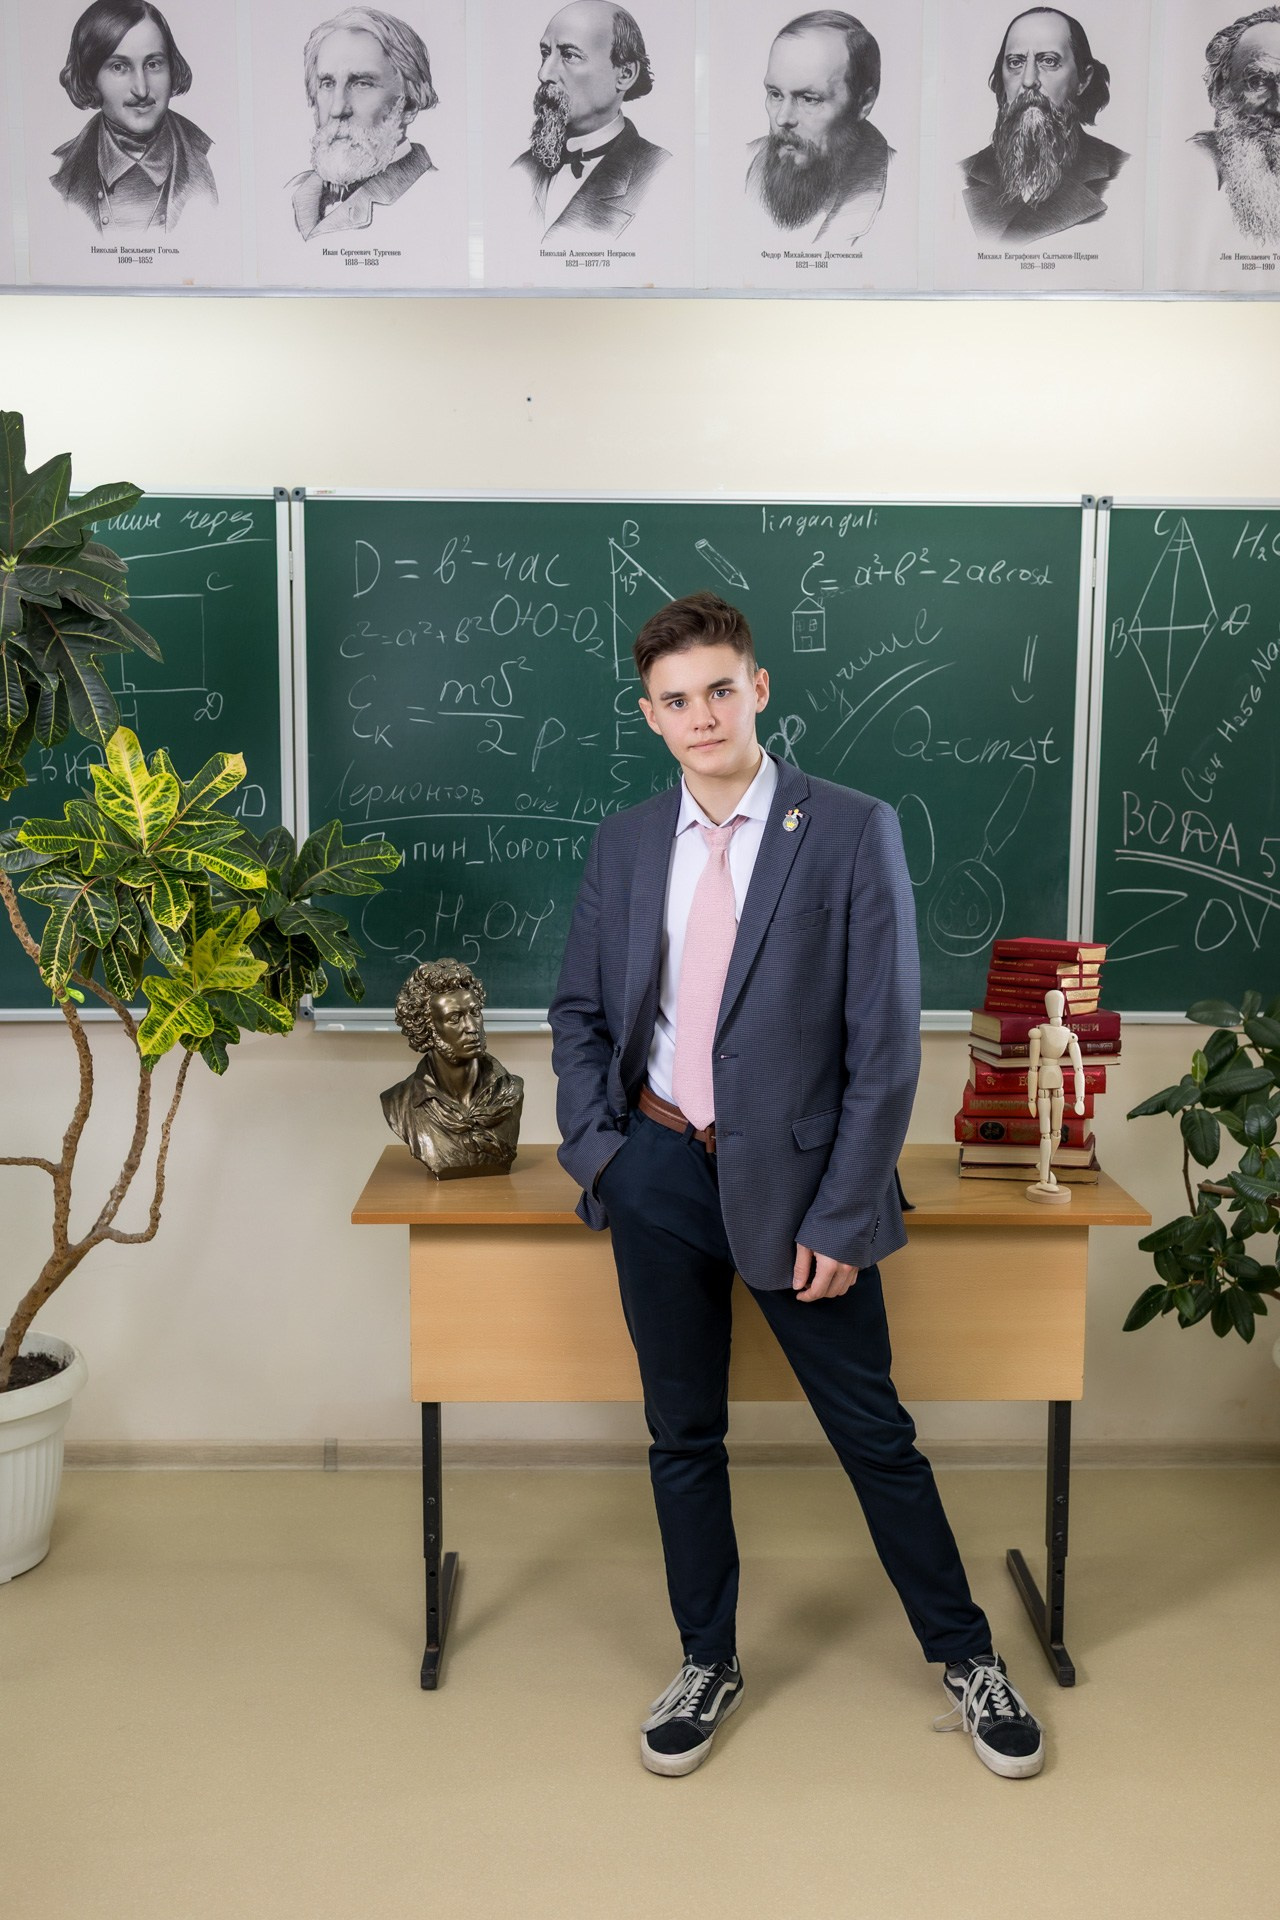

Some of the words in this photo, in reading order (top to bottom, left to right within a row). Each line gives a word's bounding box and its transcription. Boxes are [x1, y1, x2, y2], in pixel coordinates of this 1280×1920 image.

[90, 246, 118, 254] Николай
[120, 246, 156, 254] Васильевич
[158, 246, 180, 254] Гоголь
[322, 248, 338, 256] Иван
[340, 248, 371, 257] Сергеевич
[373, 248, 402, 257] Тургенев
[539, 249, 566, 257] Николай
[569, 249, 605, 257] Алексеевич
[607, 249, 636, 258] Некрасов
[761, 251, 781, 259] Федор
[824, 251, 863, 259] Достоевский
[977, 252, 1002, 260] Михаил
[1004, 252, 1040, 261] Евграфович
[1042, 252, 1099, 261] Салтыков-Щедрин
[180, 510, 254, 542] через
[762, 506, 879, 537] linganguli
[325, 760, 484, 820] Лермонтов
